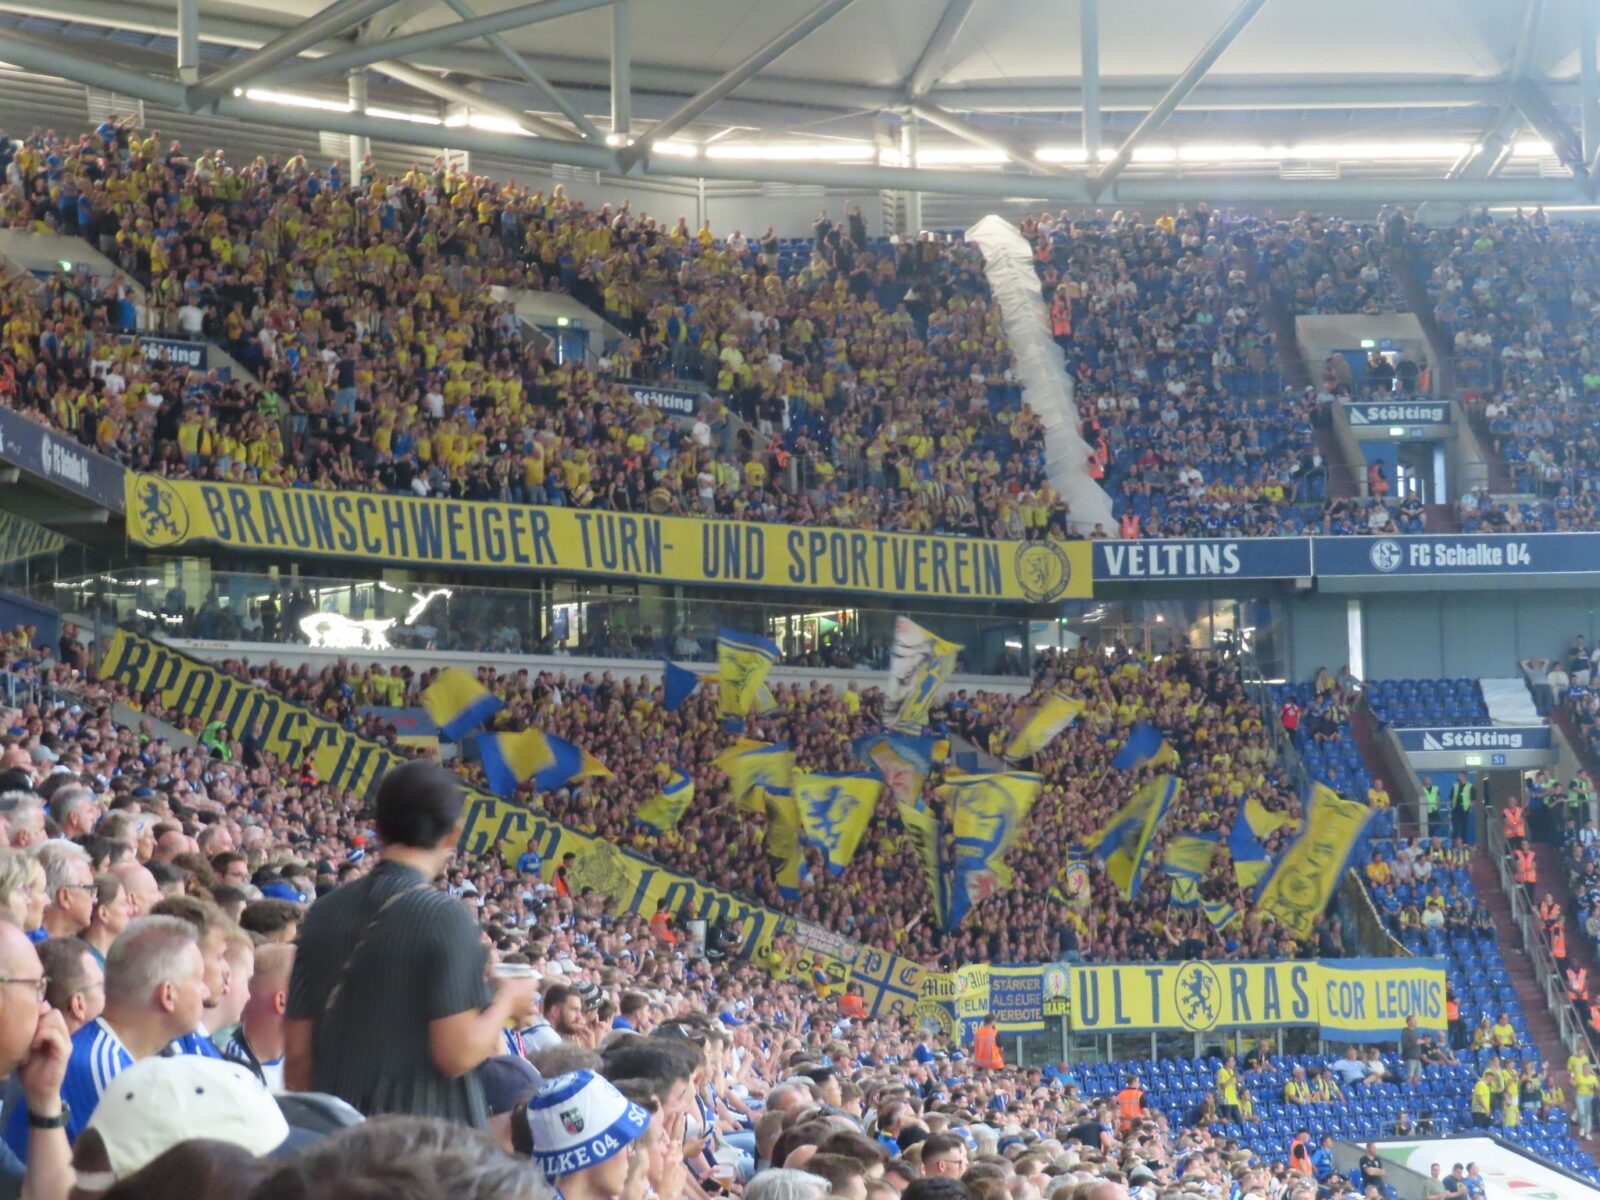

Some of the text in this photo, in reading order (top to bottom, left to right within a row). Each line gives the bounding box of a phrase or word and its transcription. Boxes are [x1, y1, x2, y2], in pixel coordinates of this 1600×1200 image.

[143, 343, 200, 366] tölting
[1368, 406, 1443, 421] Stölting
[202, 485, 557, 565] BRAUNSCHWEIGER
[575, 513, 673, 575] TURN-
[702, 523, 764, 581] UND
[788, 530, 1000, 595] SPORTVEREIN
[1104, 543, 1241, 576] VELTINS
[1410, 543, 1531, 566] FC Schalke 04
[1442, 731, 1523, 748] Stölting
[1326, 979, 1442, 1020] COR LEONIS
[592, 1132, 619, 1158] 04
